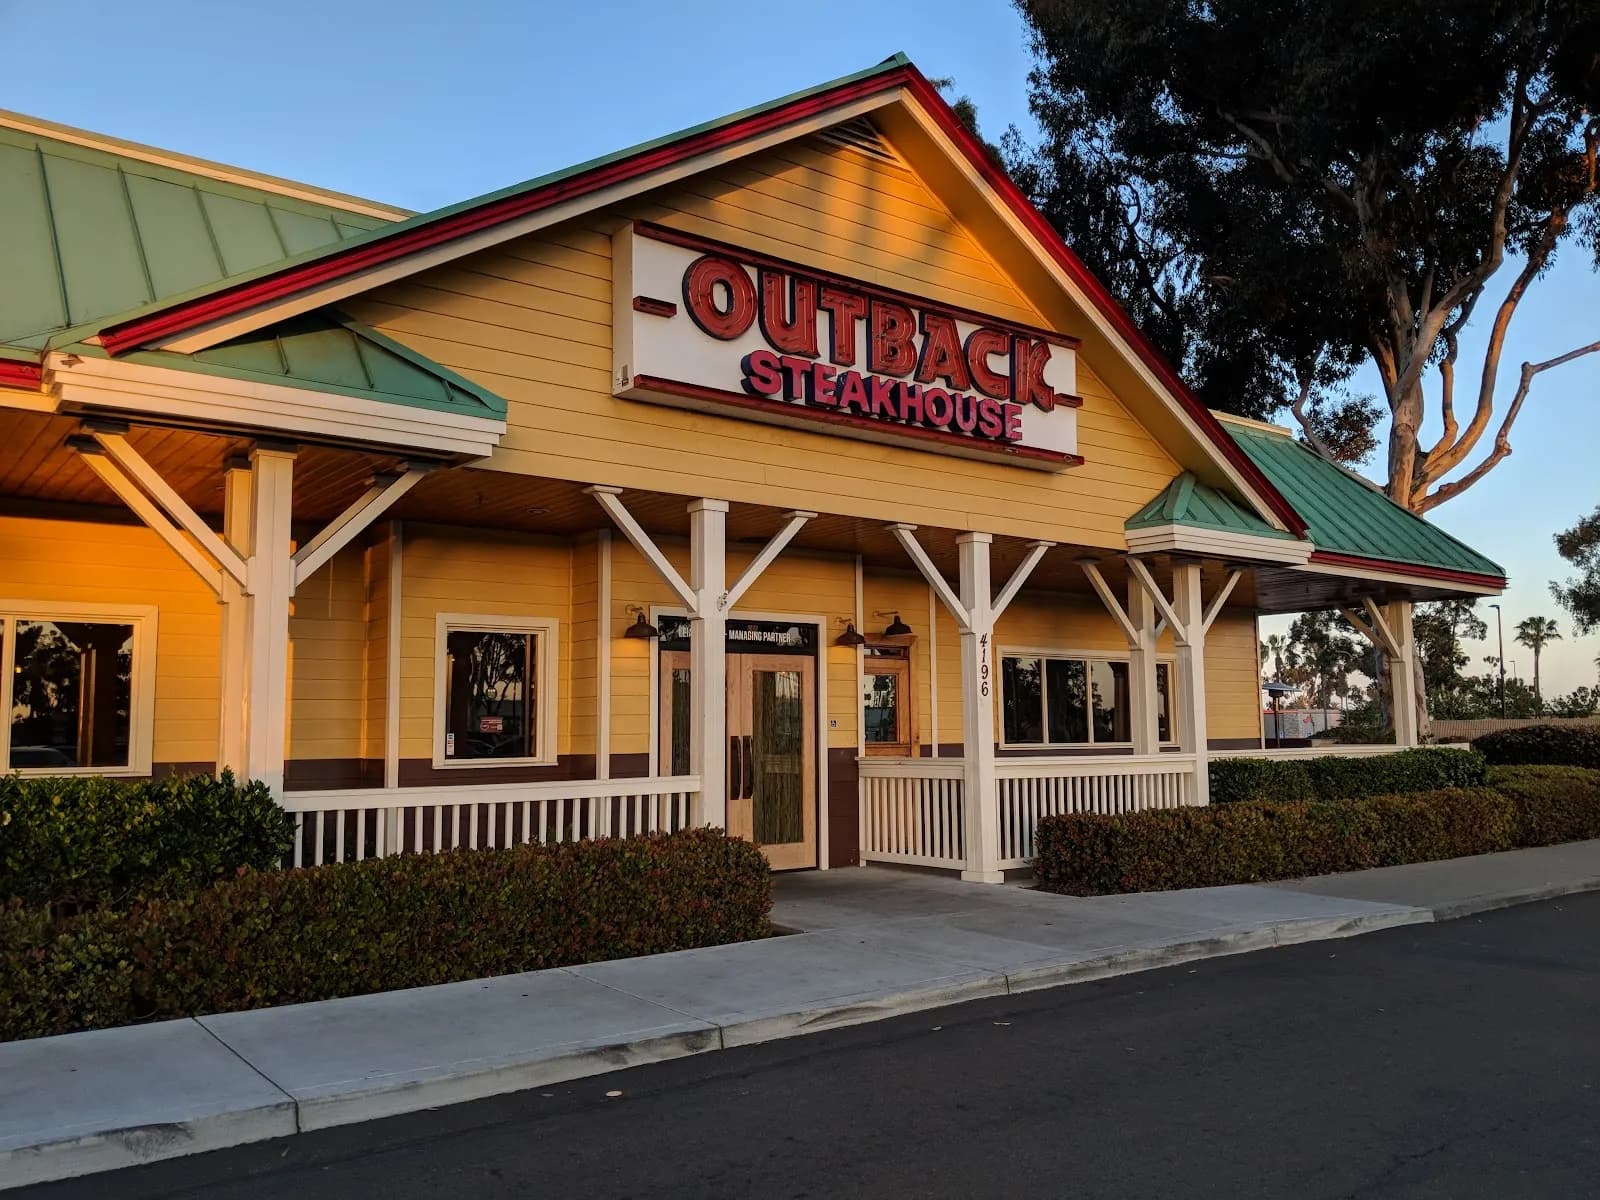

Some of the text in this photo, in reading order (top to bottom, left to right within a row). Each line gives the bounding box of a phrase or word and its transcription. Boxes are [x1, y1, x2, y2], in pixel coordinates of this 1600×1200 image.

[682, 254, 1055, 412] OUTBACK
[742, 350, 1023, 441] STEAKHOUSE
[728, 629, 762, 642] MANAGING
[763, 631, 791, 643] PARTNER
[979, 632, 989, 697] 4196
